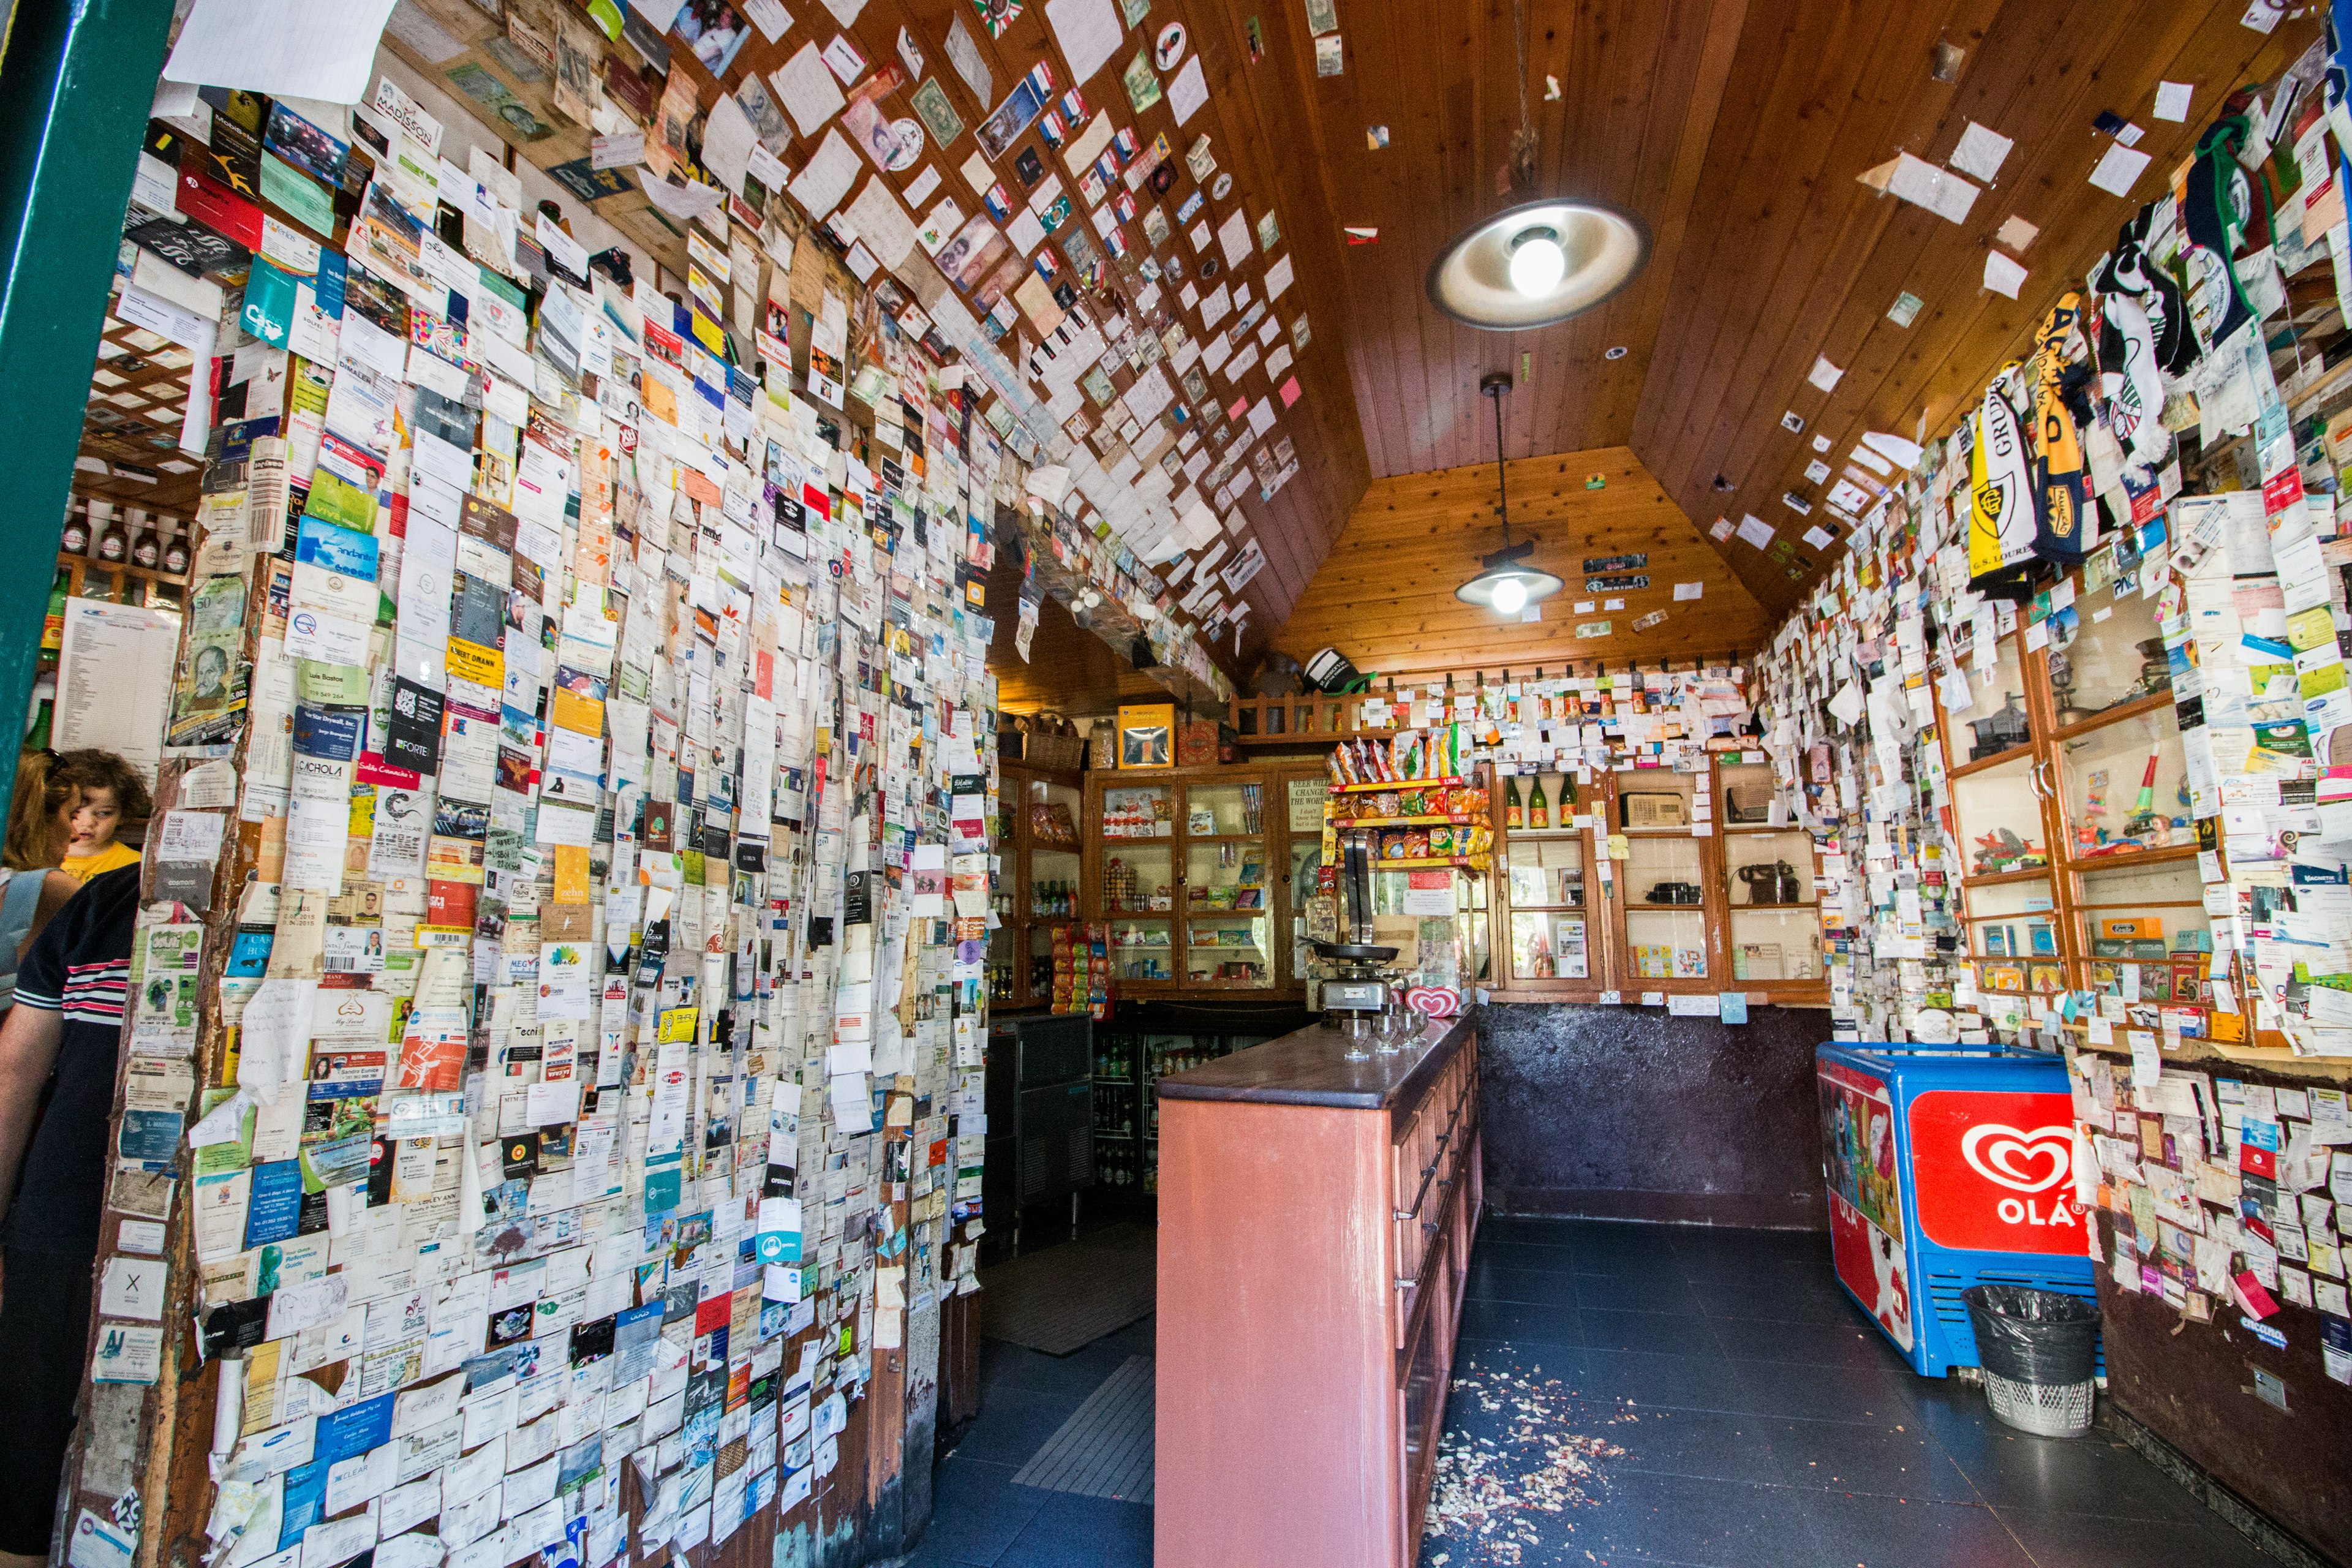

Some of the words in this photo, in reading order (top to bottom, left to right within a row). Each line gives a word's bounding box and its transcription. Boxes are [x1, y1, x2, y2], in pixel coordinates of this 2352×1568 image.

[377, 96, 432, 143] MADISSON
[337, 545, 376, 562] andante
[1994, 546, 2031, 563] LOURE
[402, 739, 428, 757] FORTE
[377, 821, 404, 831] MADEIRA
[561, 886, 584, 897] zehn
[1997, 1194, 2076, 1227] OLÁ
[285, 1250, 318, 1262] Reference
[284, 1261, 304, 1270] Guide
[374, 1355, 392, 1366] LAURITA
[393, 1349, 415, 1360] OLIVEIRA
[341, 1464, 368, 1480] CLEAR
